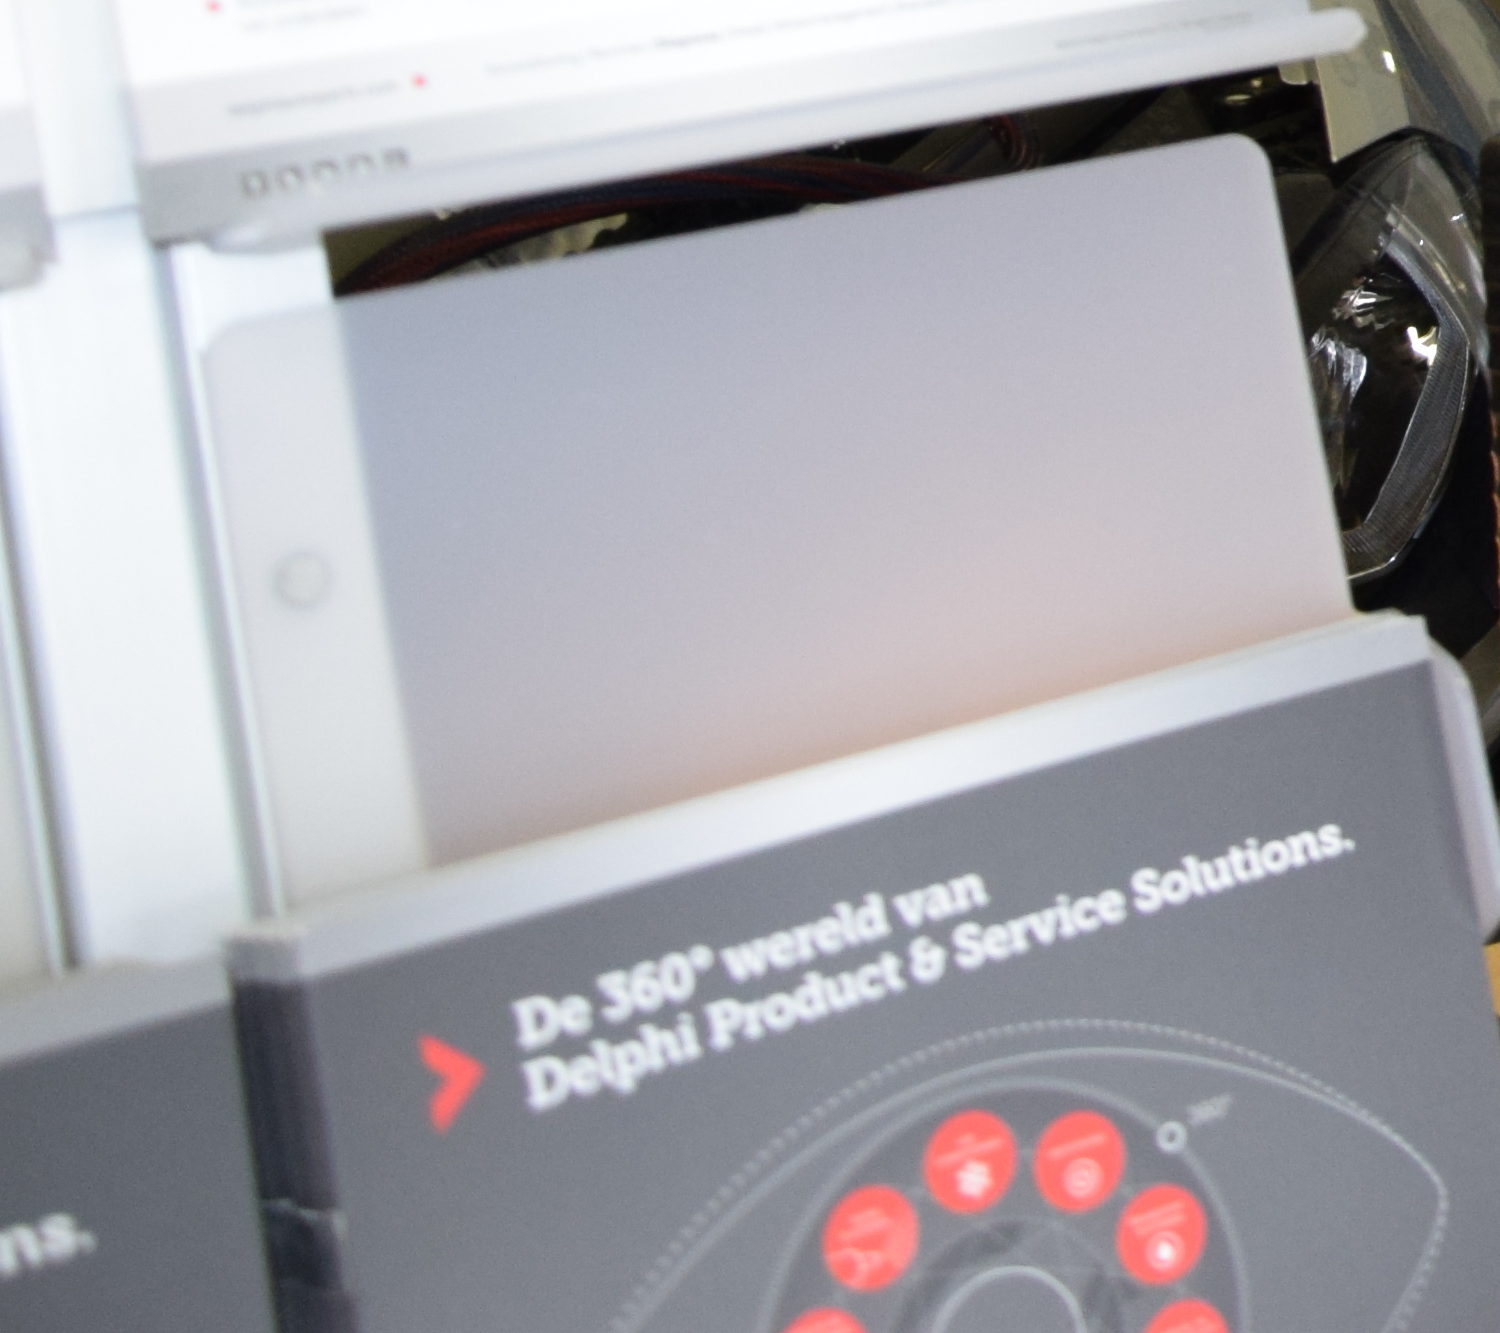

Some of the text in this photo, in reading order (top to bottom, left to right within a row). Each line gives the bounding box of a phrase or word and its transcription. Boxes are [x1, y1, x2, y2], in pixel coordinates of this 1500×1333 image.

[512, 871, 991, 1051] De 360° wereld van
[521, 821, 1358, 1110] Delphi Product & Service Solutions.
